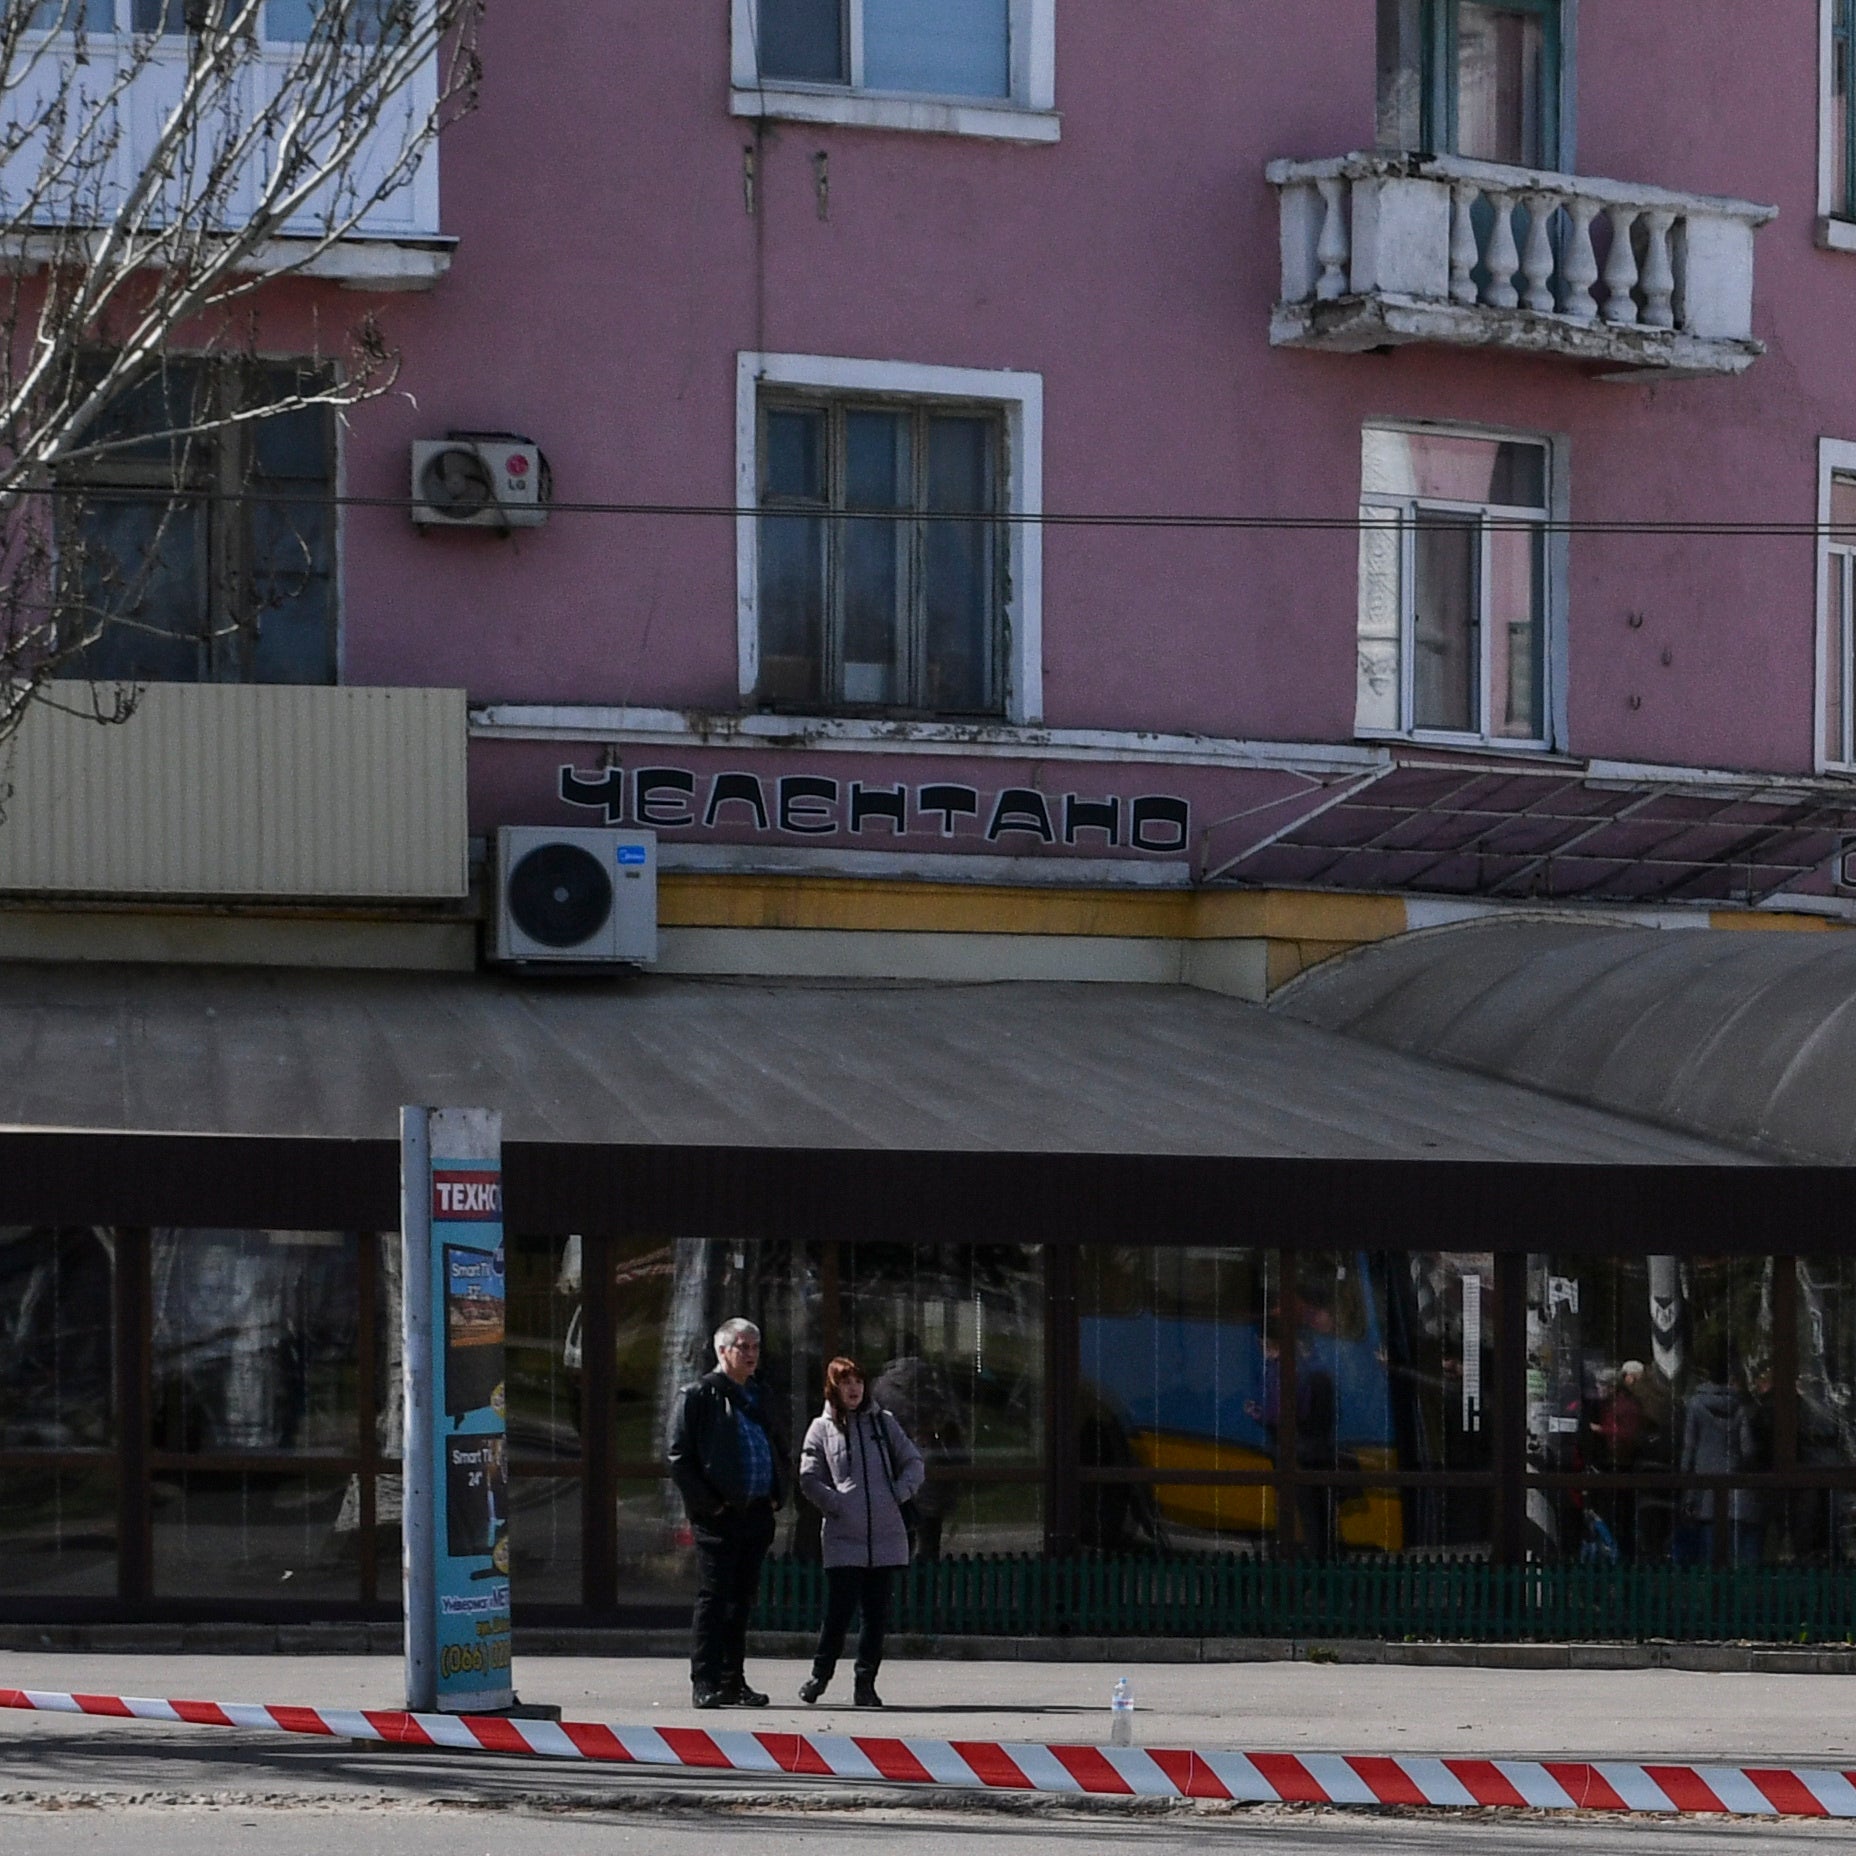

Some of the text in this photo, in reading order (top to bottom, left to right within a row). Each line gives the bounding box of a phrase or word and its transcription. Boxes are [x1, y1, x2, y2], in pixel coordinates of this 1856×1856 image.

[559, 765, 1190, 853] ЧЕЛЕНТАНО
[451, 1262, 480, 1277] Smart
[453, 1449, 481, 1465] Smart
